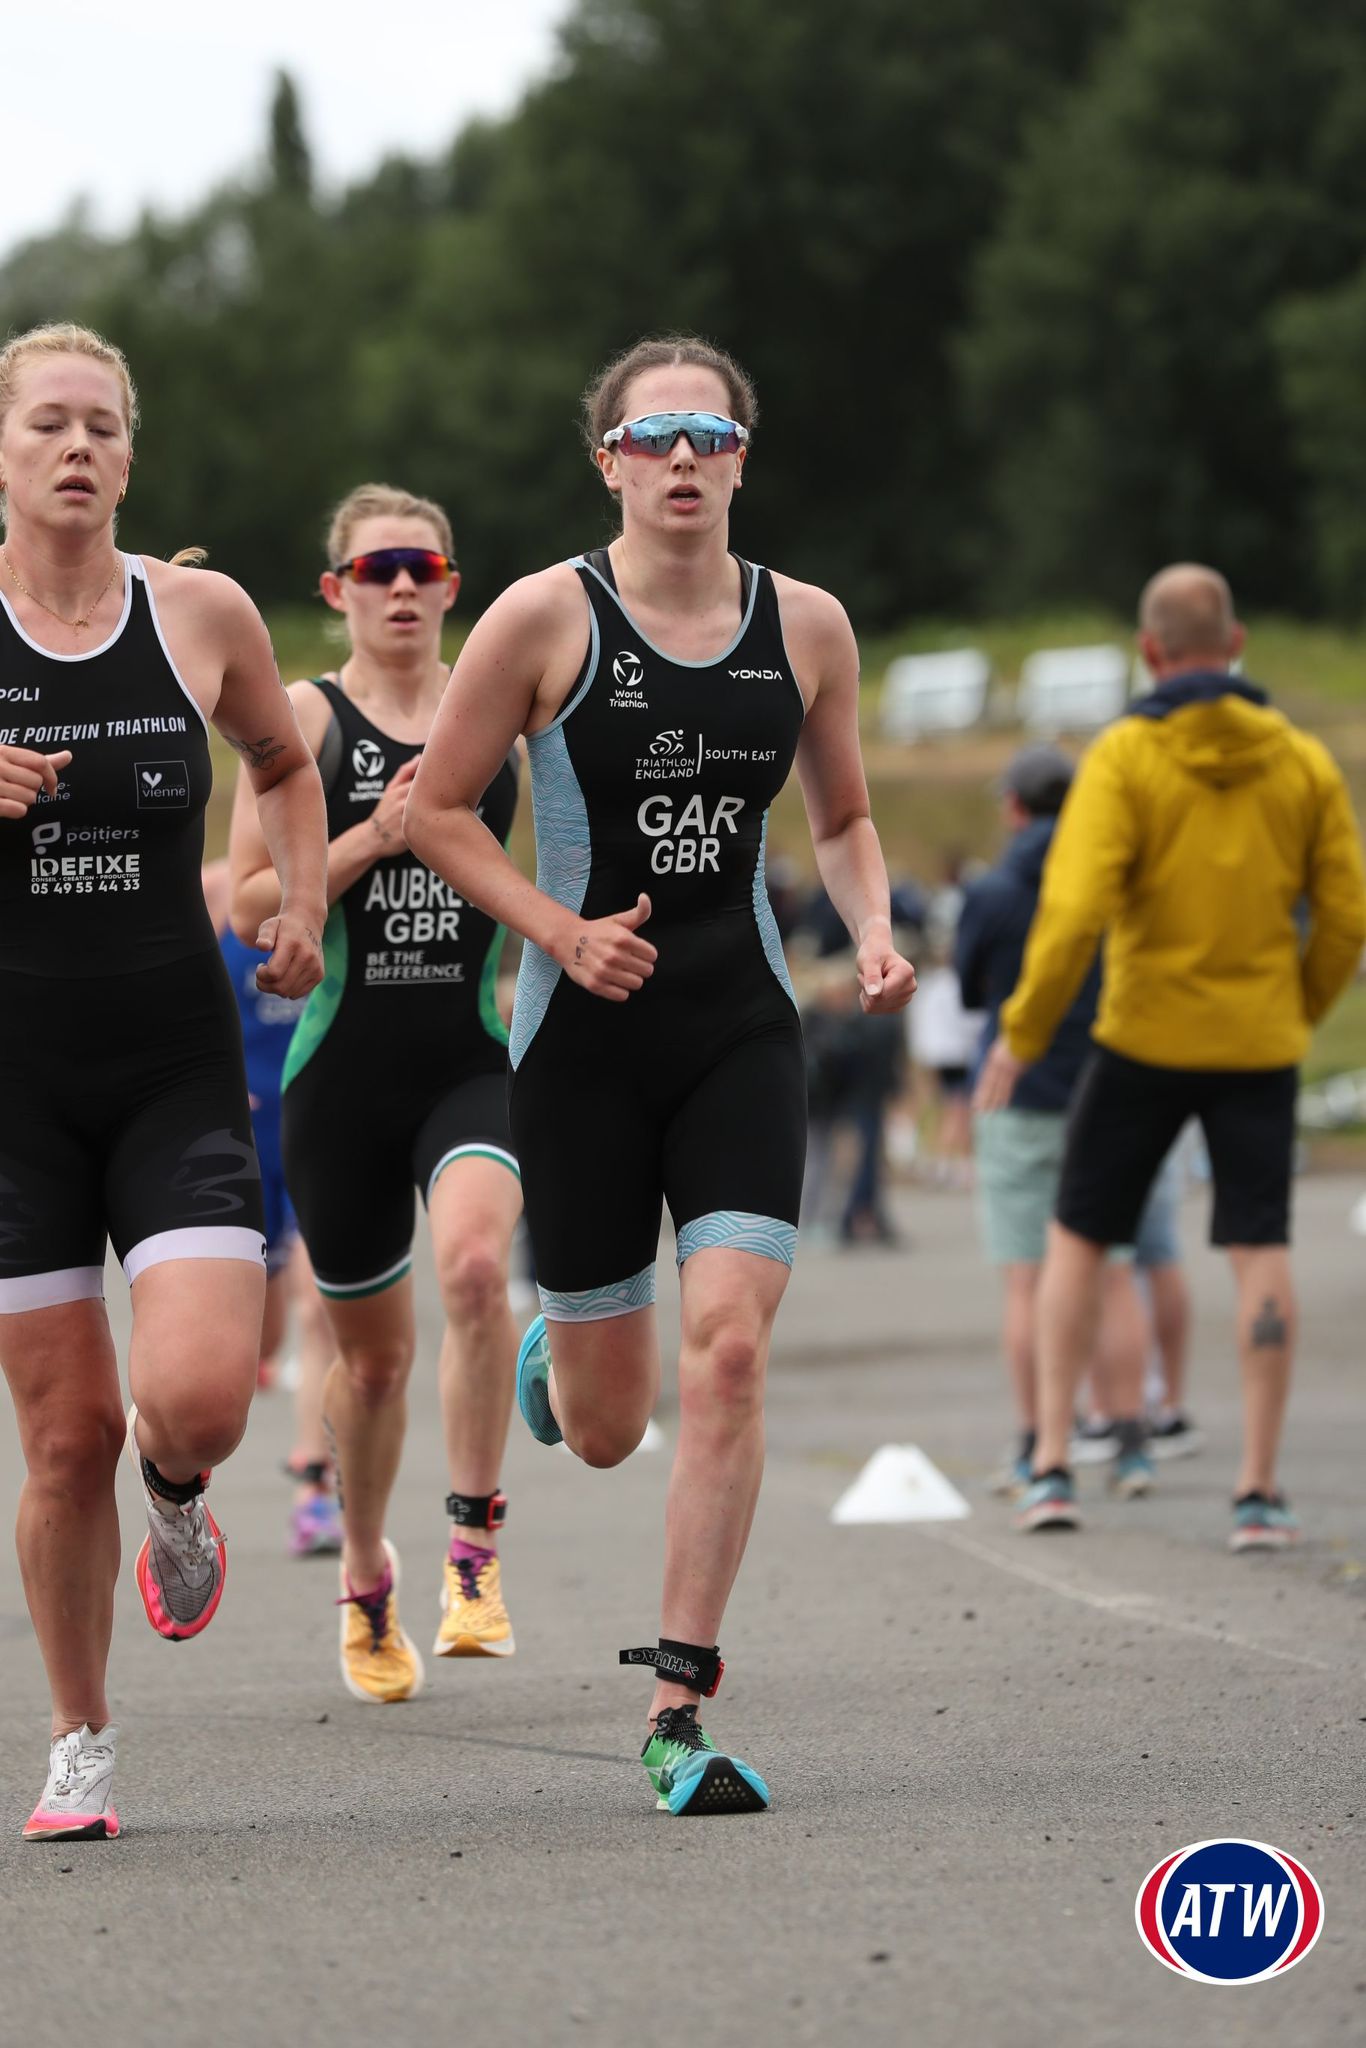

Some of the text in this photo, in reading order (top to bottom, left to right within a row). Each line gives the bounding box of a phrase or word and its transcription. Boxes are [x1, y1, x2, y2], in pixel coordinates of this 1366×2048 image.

[728, 670, 783, 680] YONDA
[615, 689, 643, 699] World
[609, 698, 648, 709] Triathlon
[23, 723, 100, 744] POITEVIN
[106, 716, 187, 738] TRIATHLON
[636, 758, 695, 768] TRIATHLON
[705, 749, 777, 761] SOUTH EAST
[635, 768, 694, 780] ENGLAND
[142, 787, 186, 798] vienne
[637, 794, 745, 837] GAR
[66, 827, 140, 846] poitiers
[650, 837, 721, 875] GBR
[31, 854, 140, 877] IDEFIXE
[31, 879, 140, 894] 05 49 55 44 33
[364, 867, 474, 911] AUBR
[384, 910, 460, 944] GBR
[366, 950, 425, 966] BE THE
[364, 963, 463, 980] DIFFERENCE
